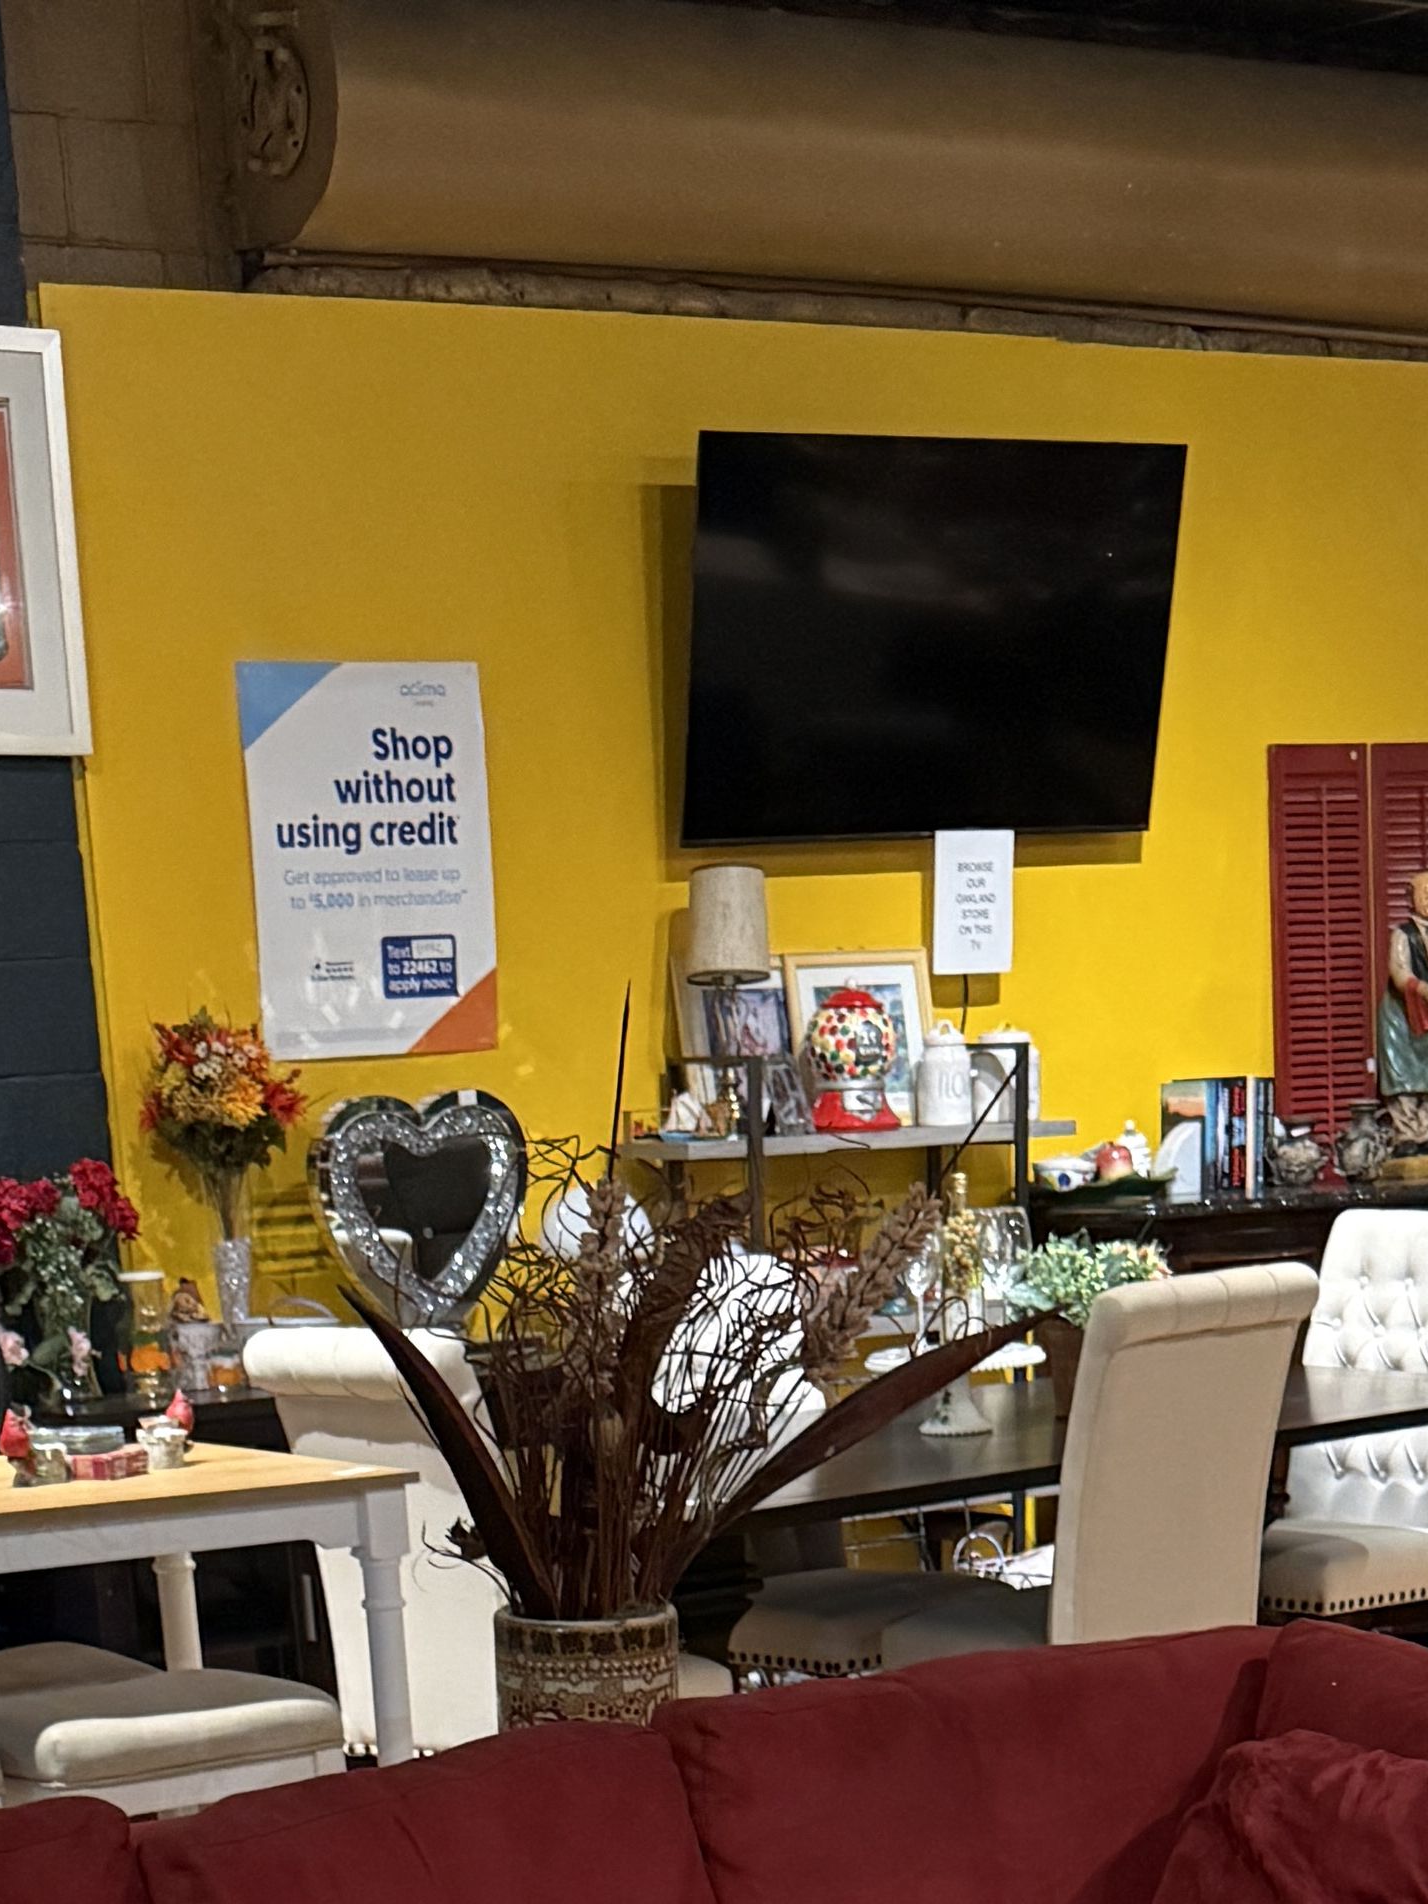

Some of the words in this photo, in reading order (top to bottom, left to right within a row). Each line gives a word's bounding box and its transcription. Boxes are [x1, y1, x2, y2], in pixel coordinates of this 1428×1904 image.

[372, 727, 454, 768] Shop
[334, 770, 456, 803] without
[276, 814, 362, 854] using
[284, 870, 310, 885] Get
[314, 868, 382, 888] approved
[385, 868, 400, 882] to
[441, 869, 460, 884] up
[290, 896, 306, 909] to
